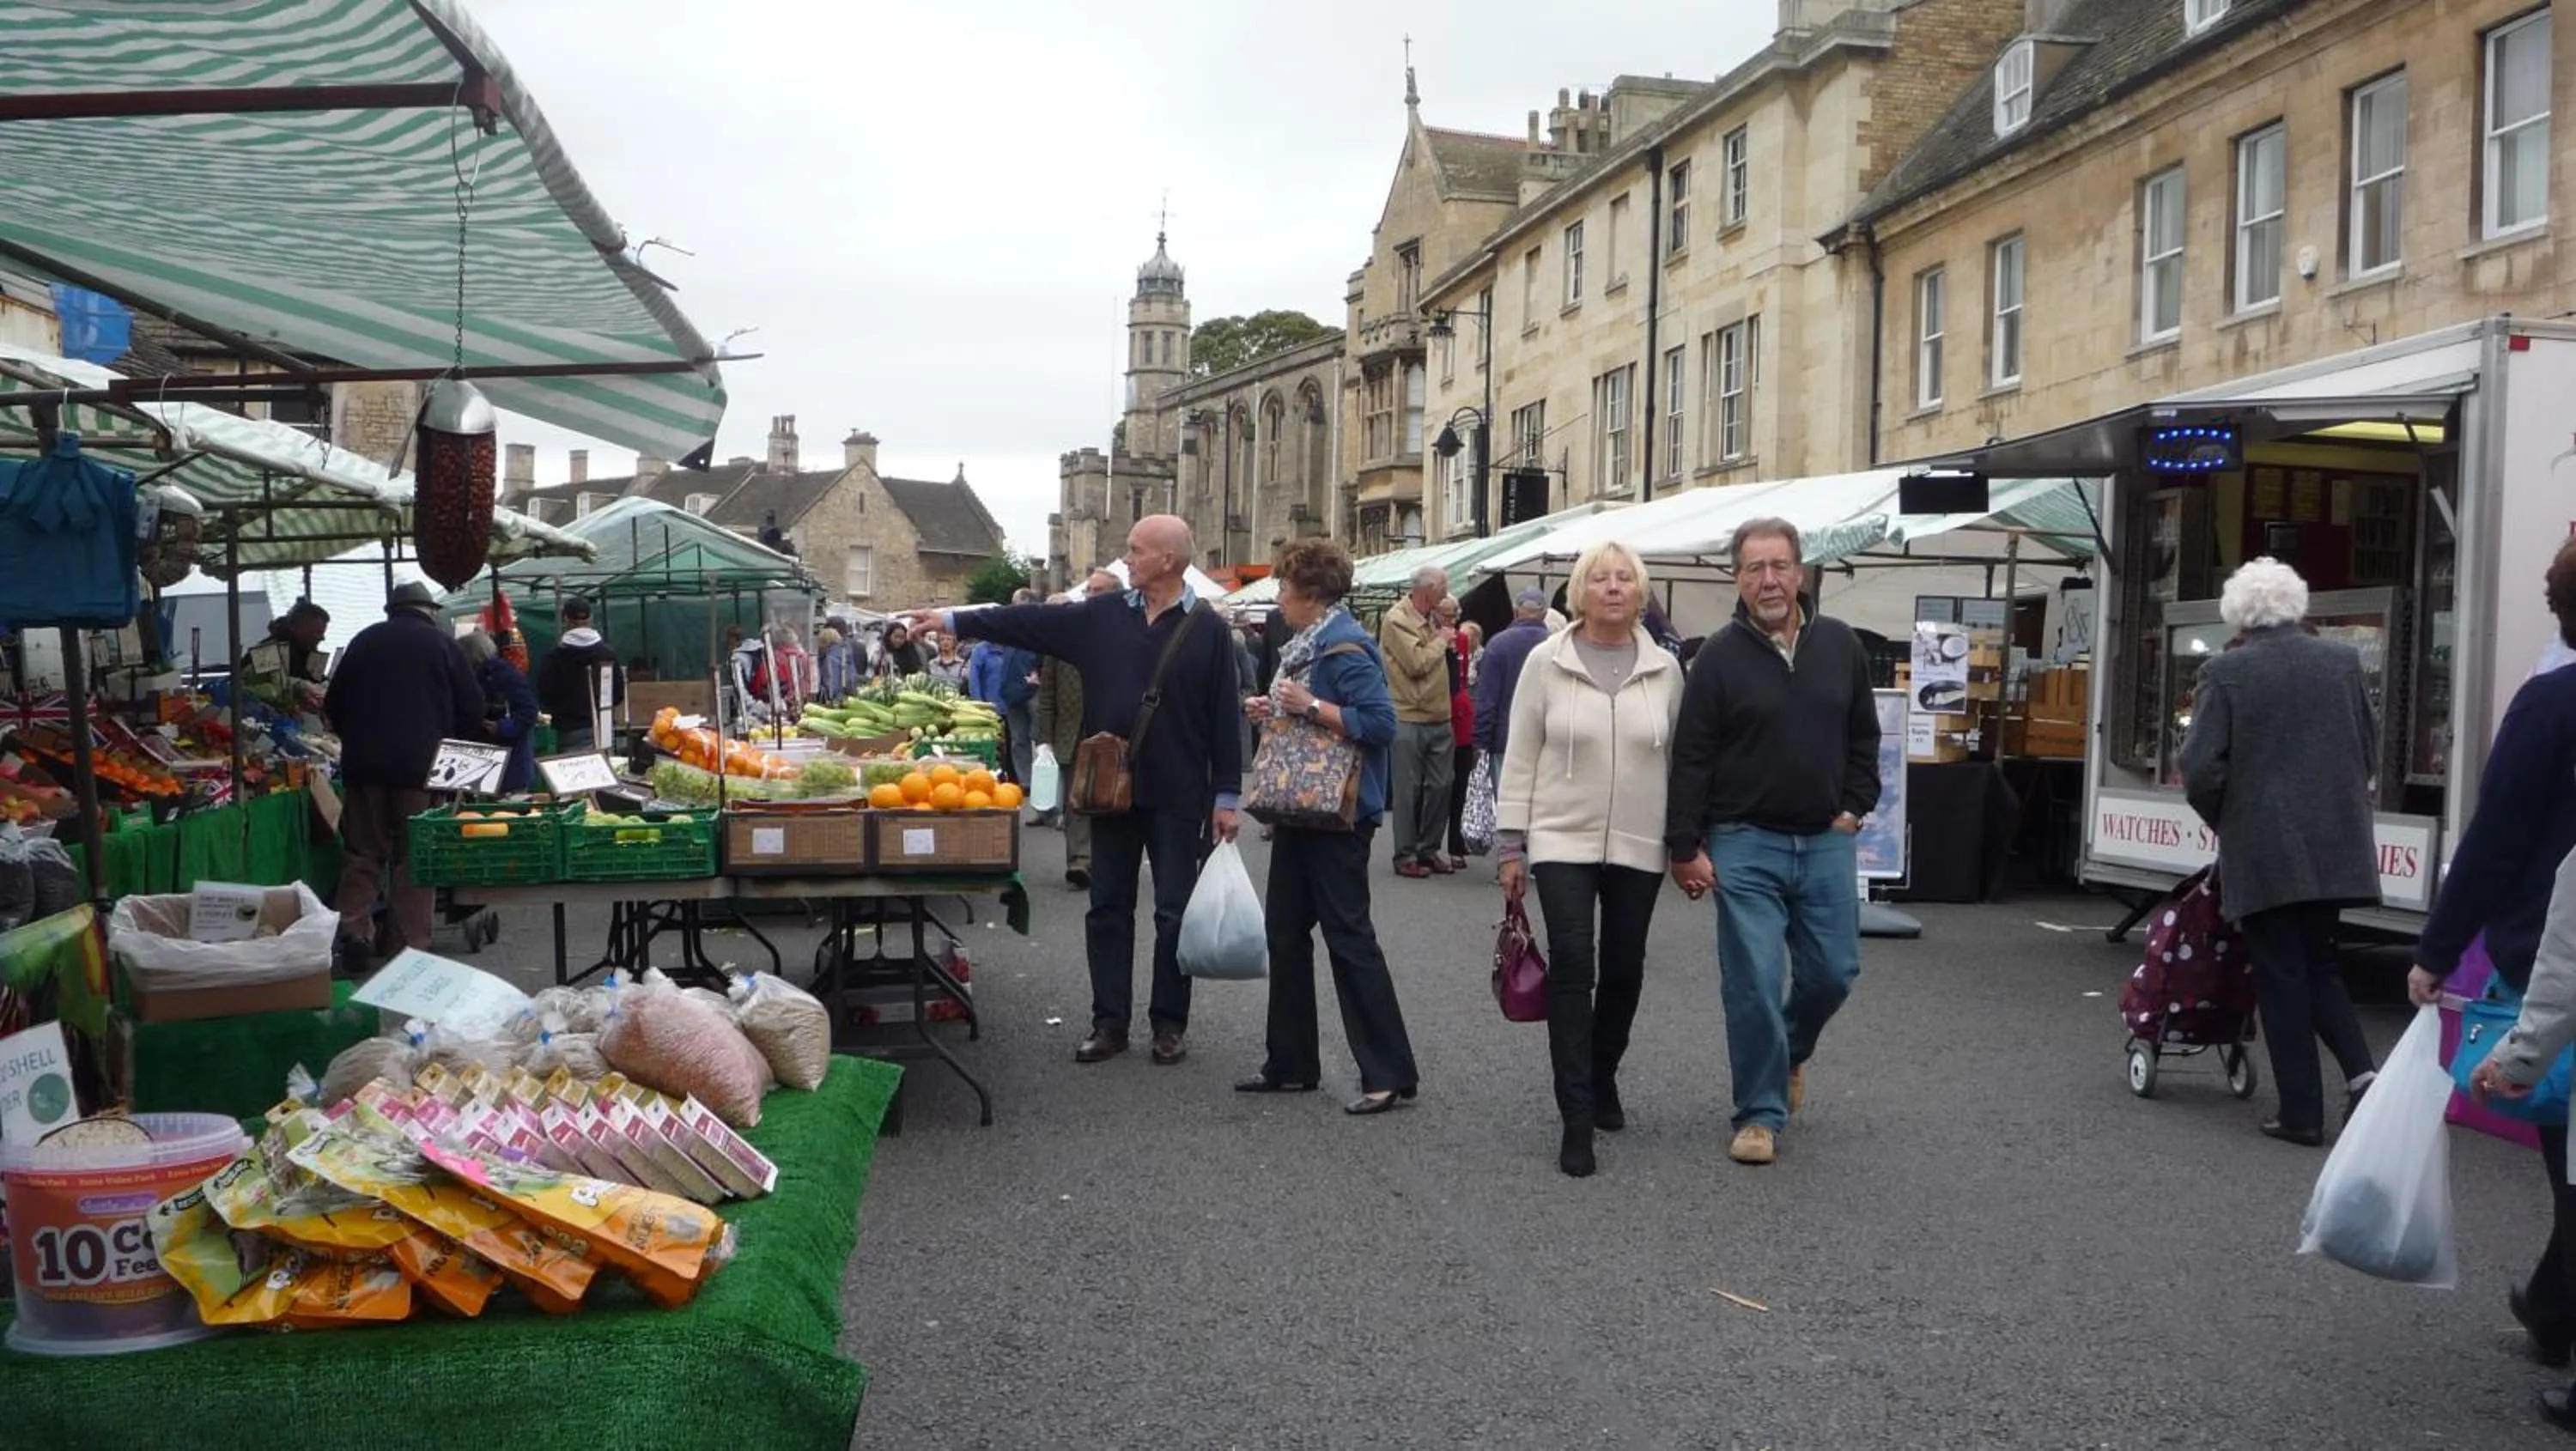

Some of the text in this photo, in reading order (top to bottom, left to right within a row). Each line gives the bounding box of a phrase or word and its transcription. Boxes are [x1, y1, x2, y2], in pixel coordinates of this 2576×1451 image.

[2103, 813, 2418, 877] WATCHES ST IES
[37, 1229, 106, 1280] 10
[115, 1256, 158, 1277] Fee
